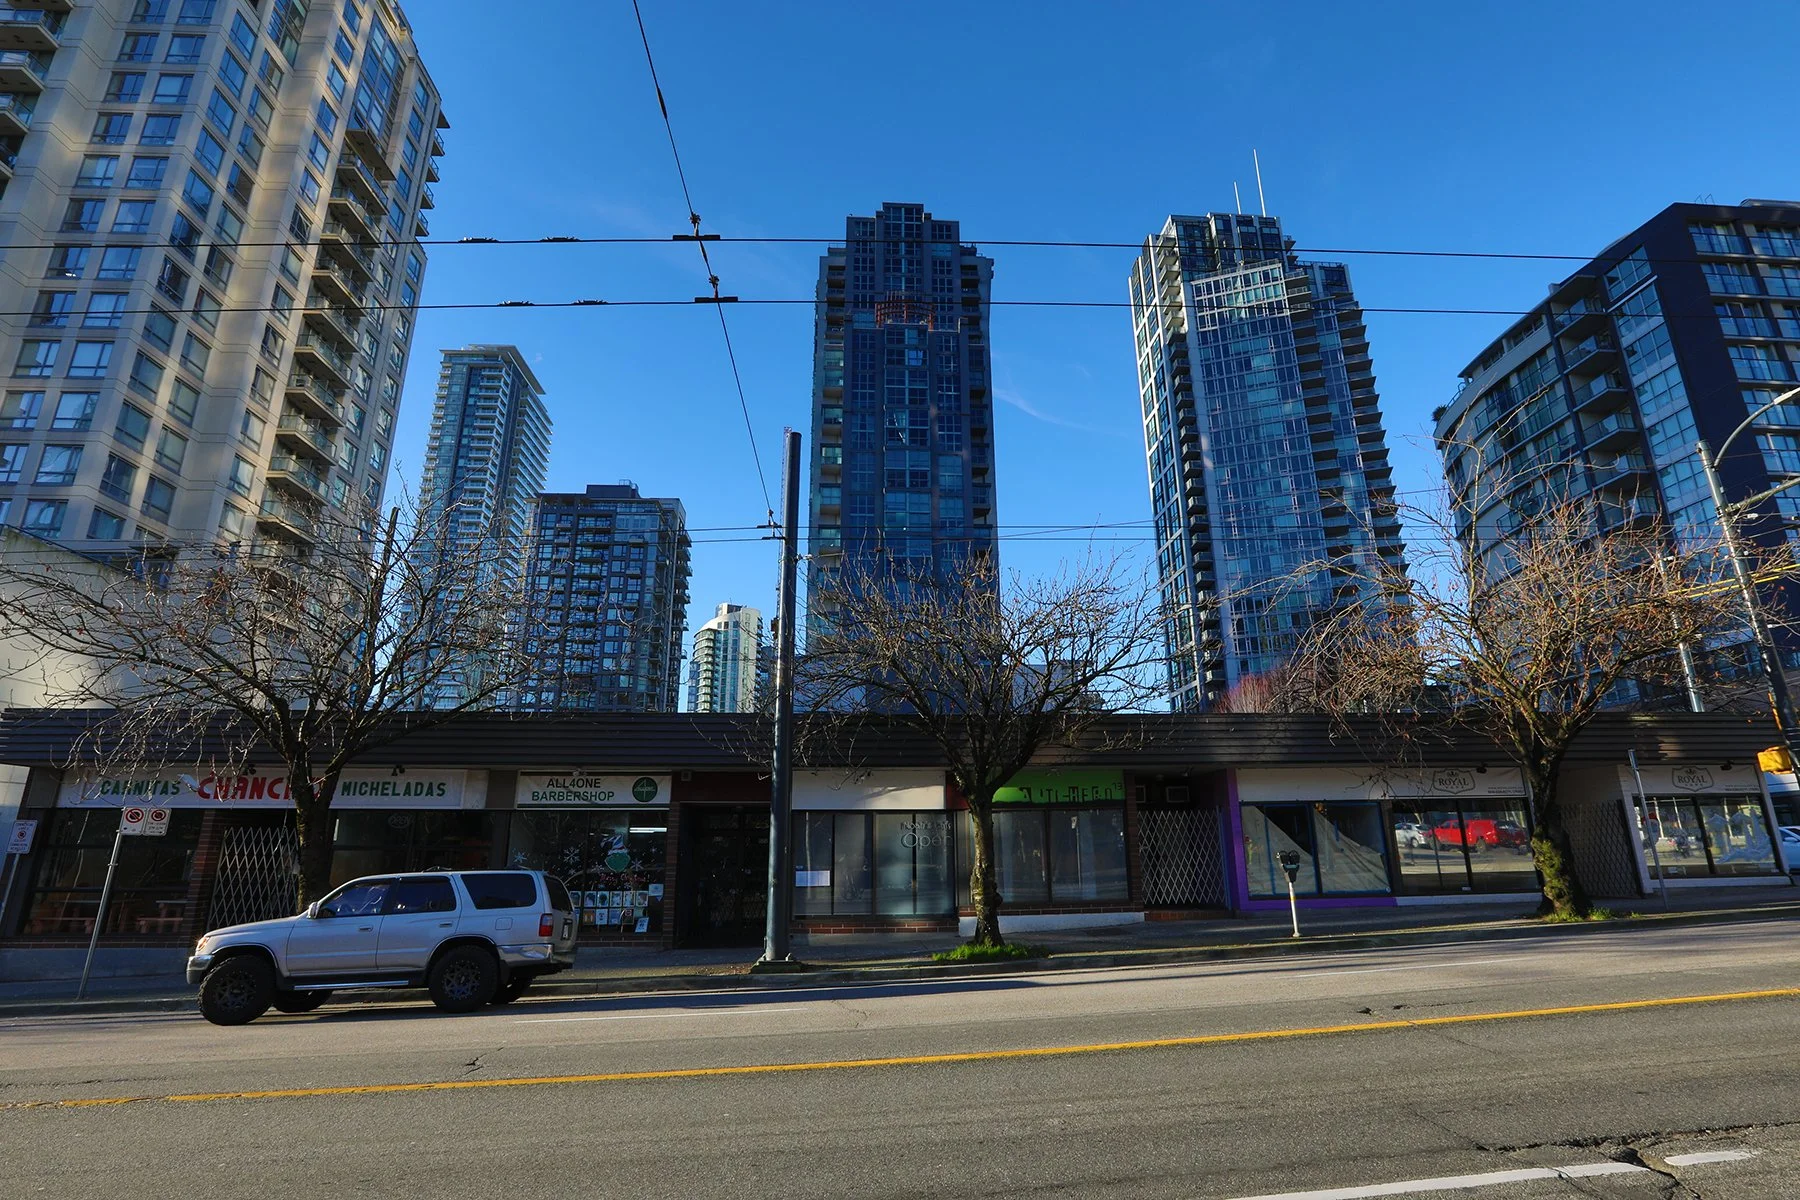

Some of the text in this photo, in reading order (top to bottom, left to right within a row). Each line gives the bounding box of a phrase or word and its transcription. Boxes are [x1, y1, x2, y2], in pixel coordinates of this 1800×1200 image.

[547, 778, 601, 788] ALL4ONE
[1439, 778, 1469, 786] ROYAL
[1678, 775, 1707, 784] ROYAL
[341, 781, 447, 797] MICHELADAS
[532, 791, 615, 801] BARBERSHOP
